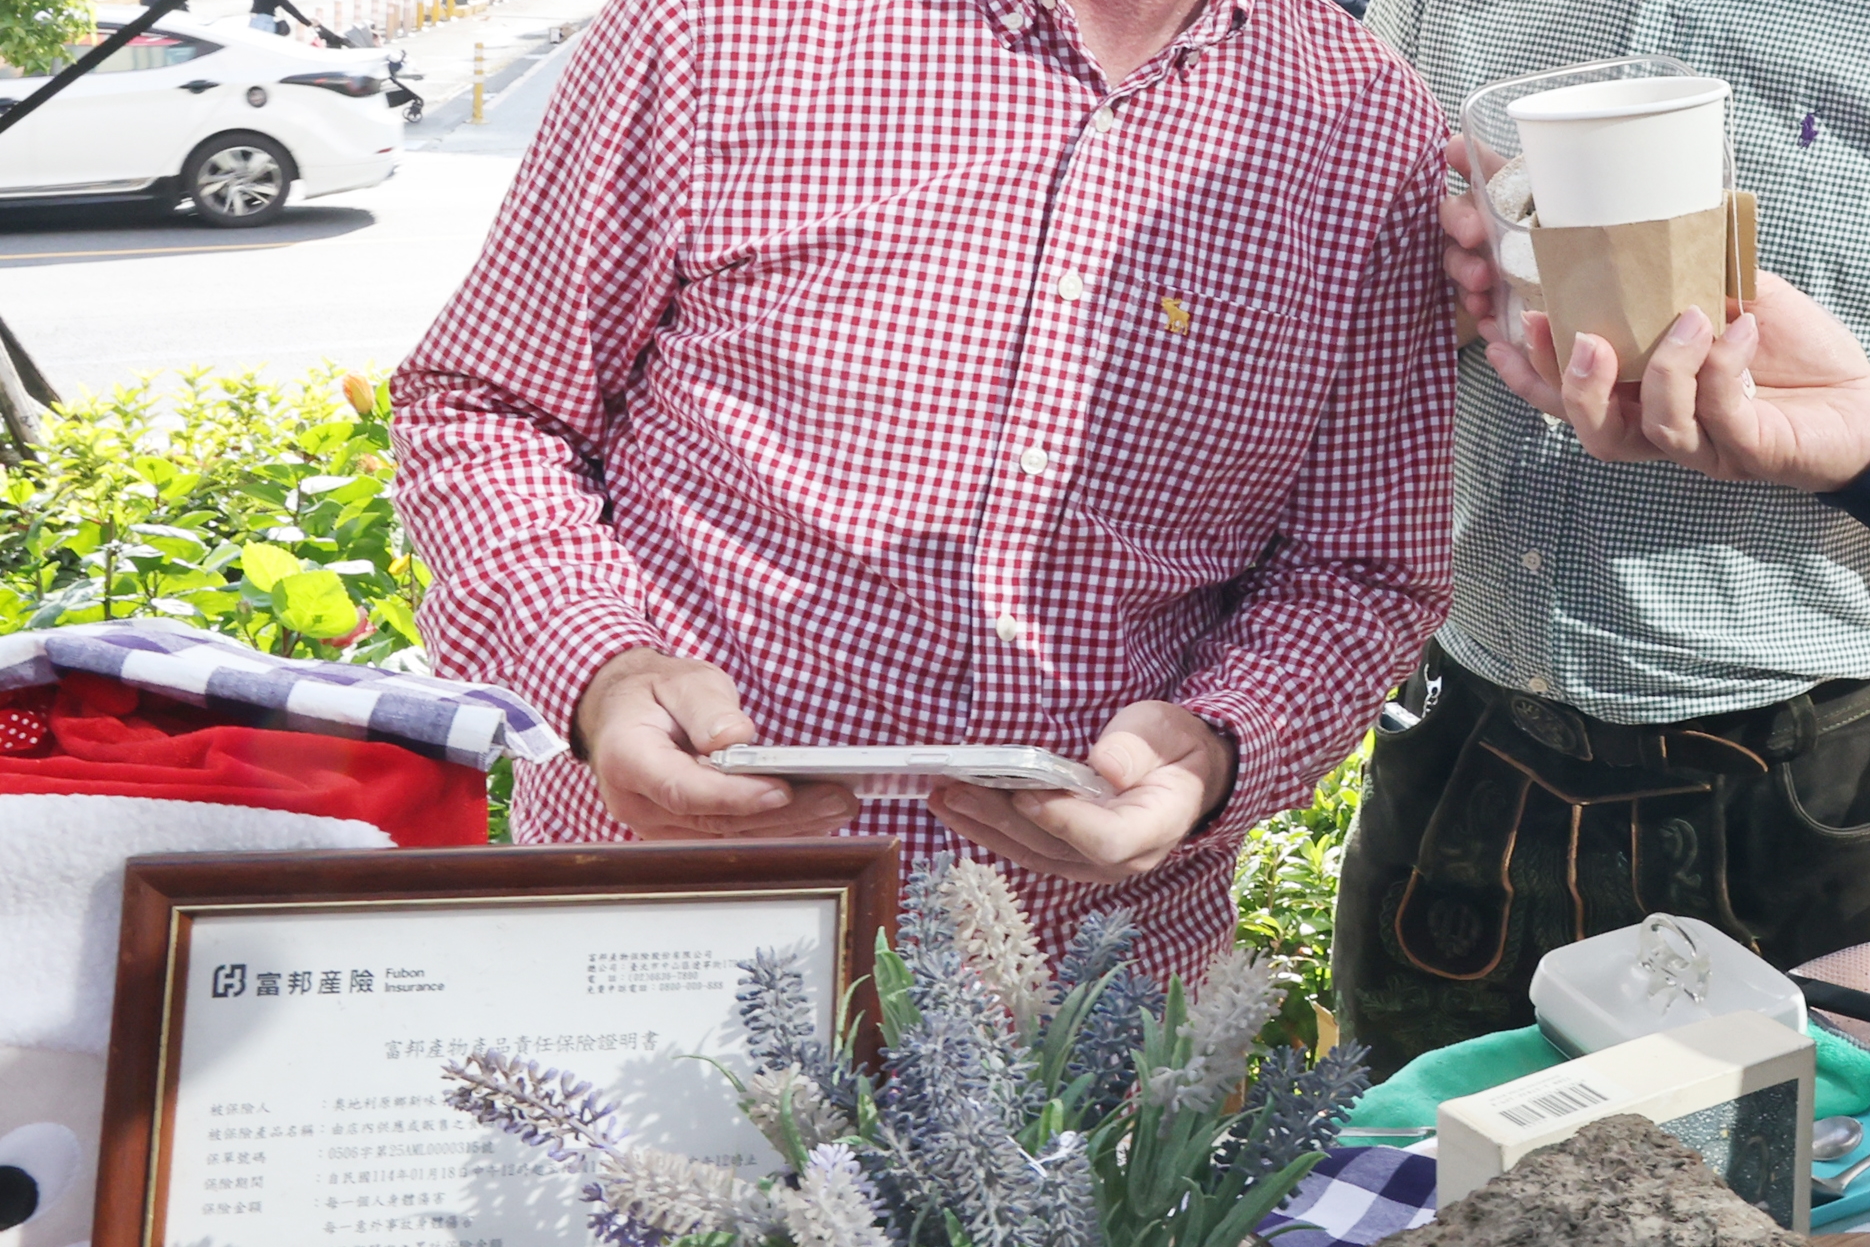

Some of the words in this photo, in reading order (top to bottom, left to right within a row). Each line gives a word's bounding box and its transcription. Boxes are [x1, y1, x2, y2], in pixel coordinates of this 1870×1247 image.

[385, 967, 425, 979] Fubon
[384, 981, 445, 993] Insurance
[209, 1102, 271, 1116] 被保險人
